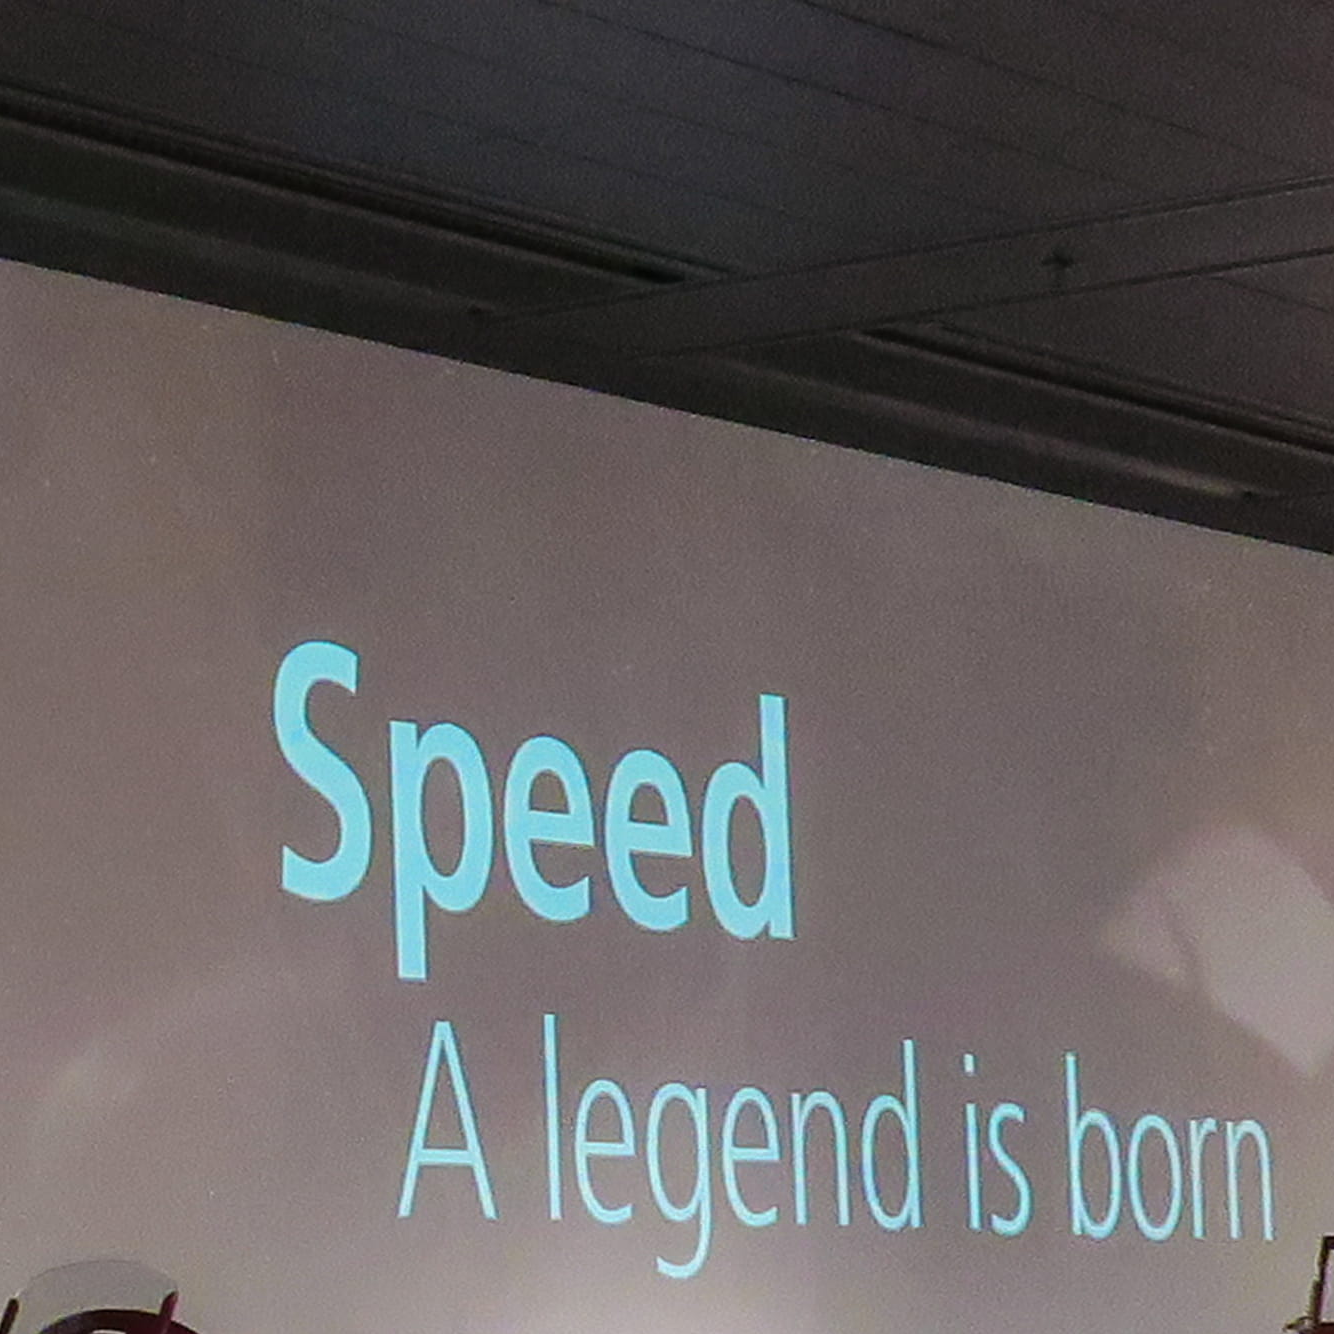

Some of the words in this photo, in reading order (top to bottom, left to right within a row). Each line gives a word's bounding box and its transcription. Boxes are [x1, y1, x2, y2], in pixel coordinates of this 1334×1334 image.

[272, 639, 797, 981] Speed
[397, 1020, 498, 1220] A
[543, 1013, 923, 1279] legend
[963, 1052, 1032, 1238] is
[1065, 1052, 1274, 1243] born
